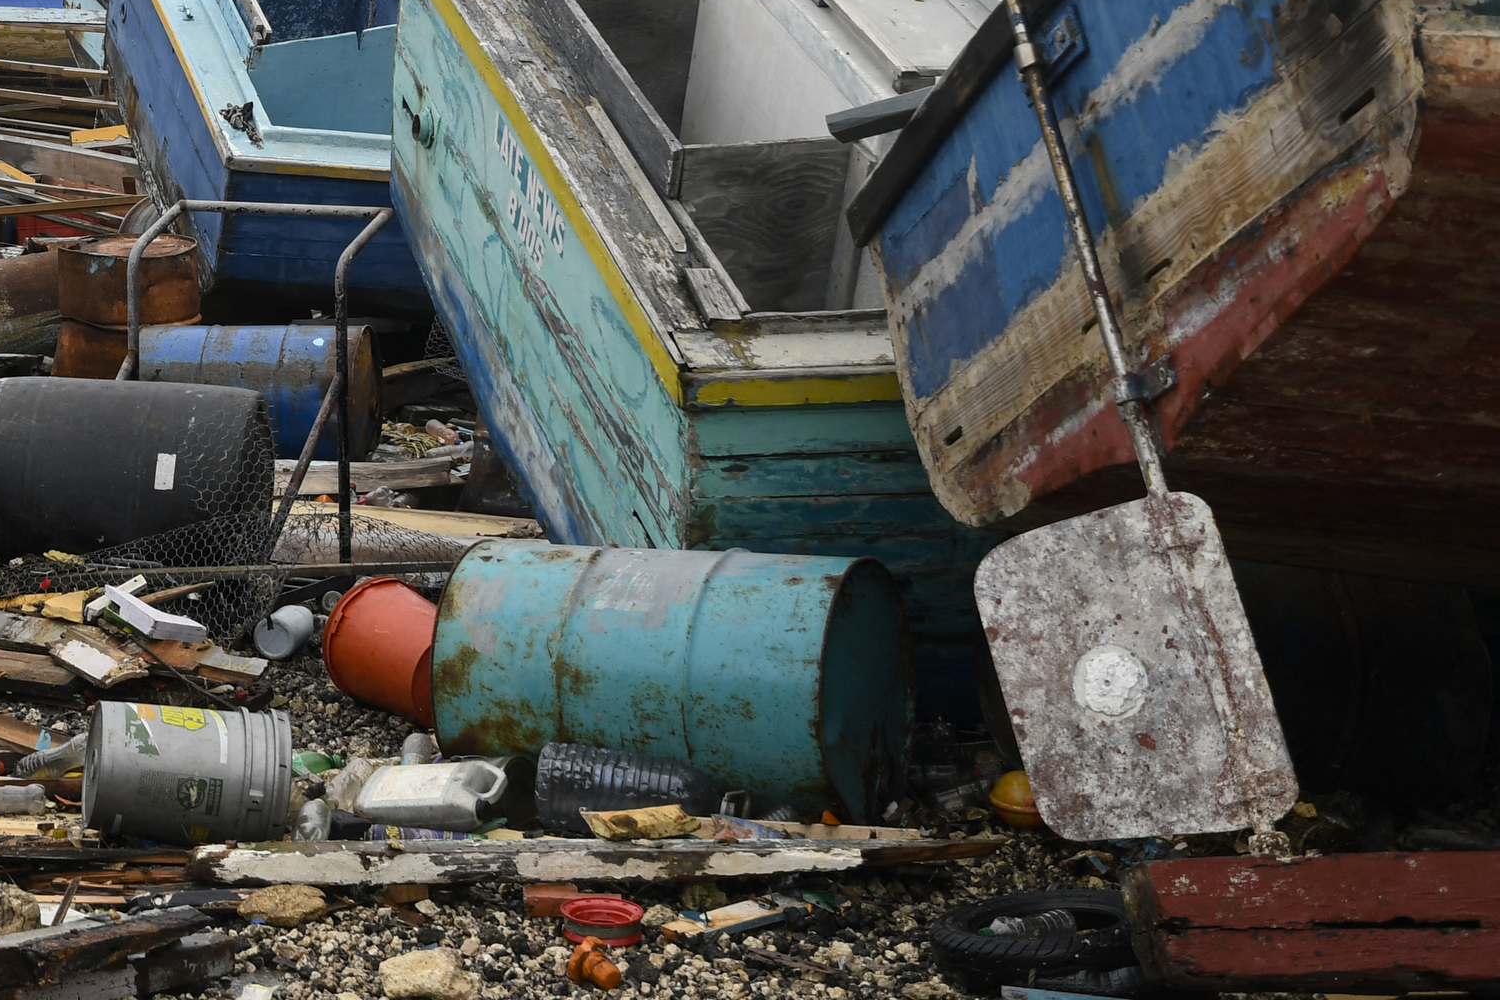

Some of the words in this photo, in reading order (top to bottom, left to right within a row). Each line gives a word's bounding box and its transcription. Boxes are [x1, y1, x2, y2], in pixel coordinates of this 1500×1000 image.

[493, 110, 524, 188] LATE
[525, 165, 566, 255] NEWS
[506, 188, 546, 272] B'DOS
